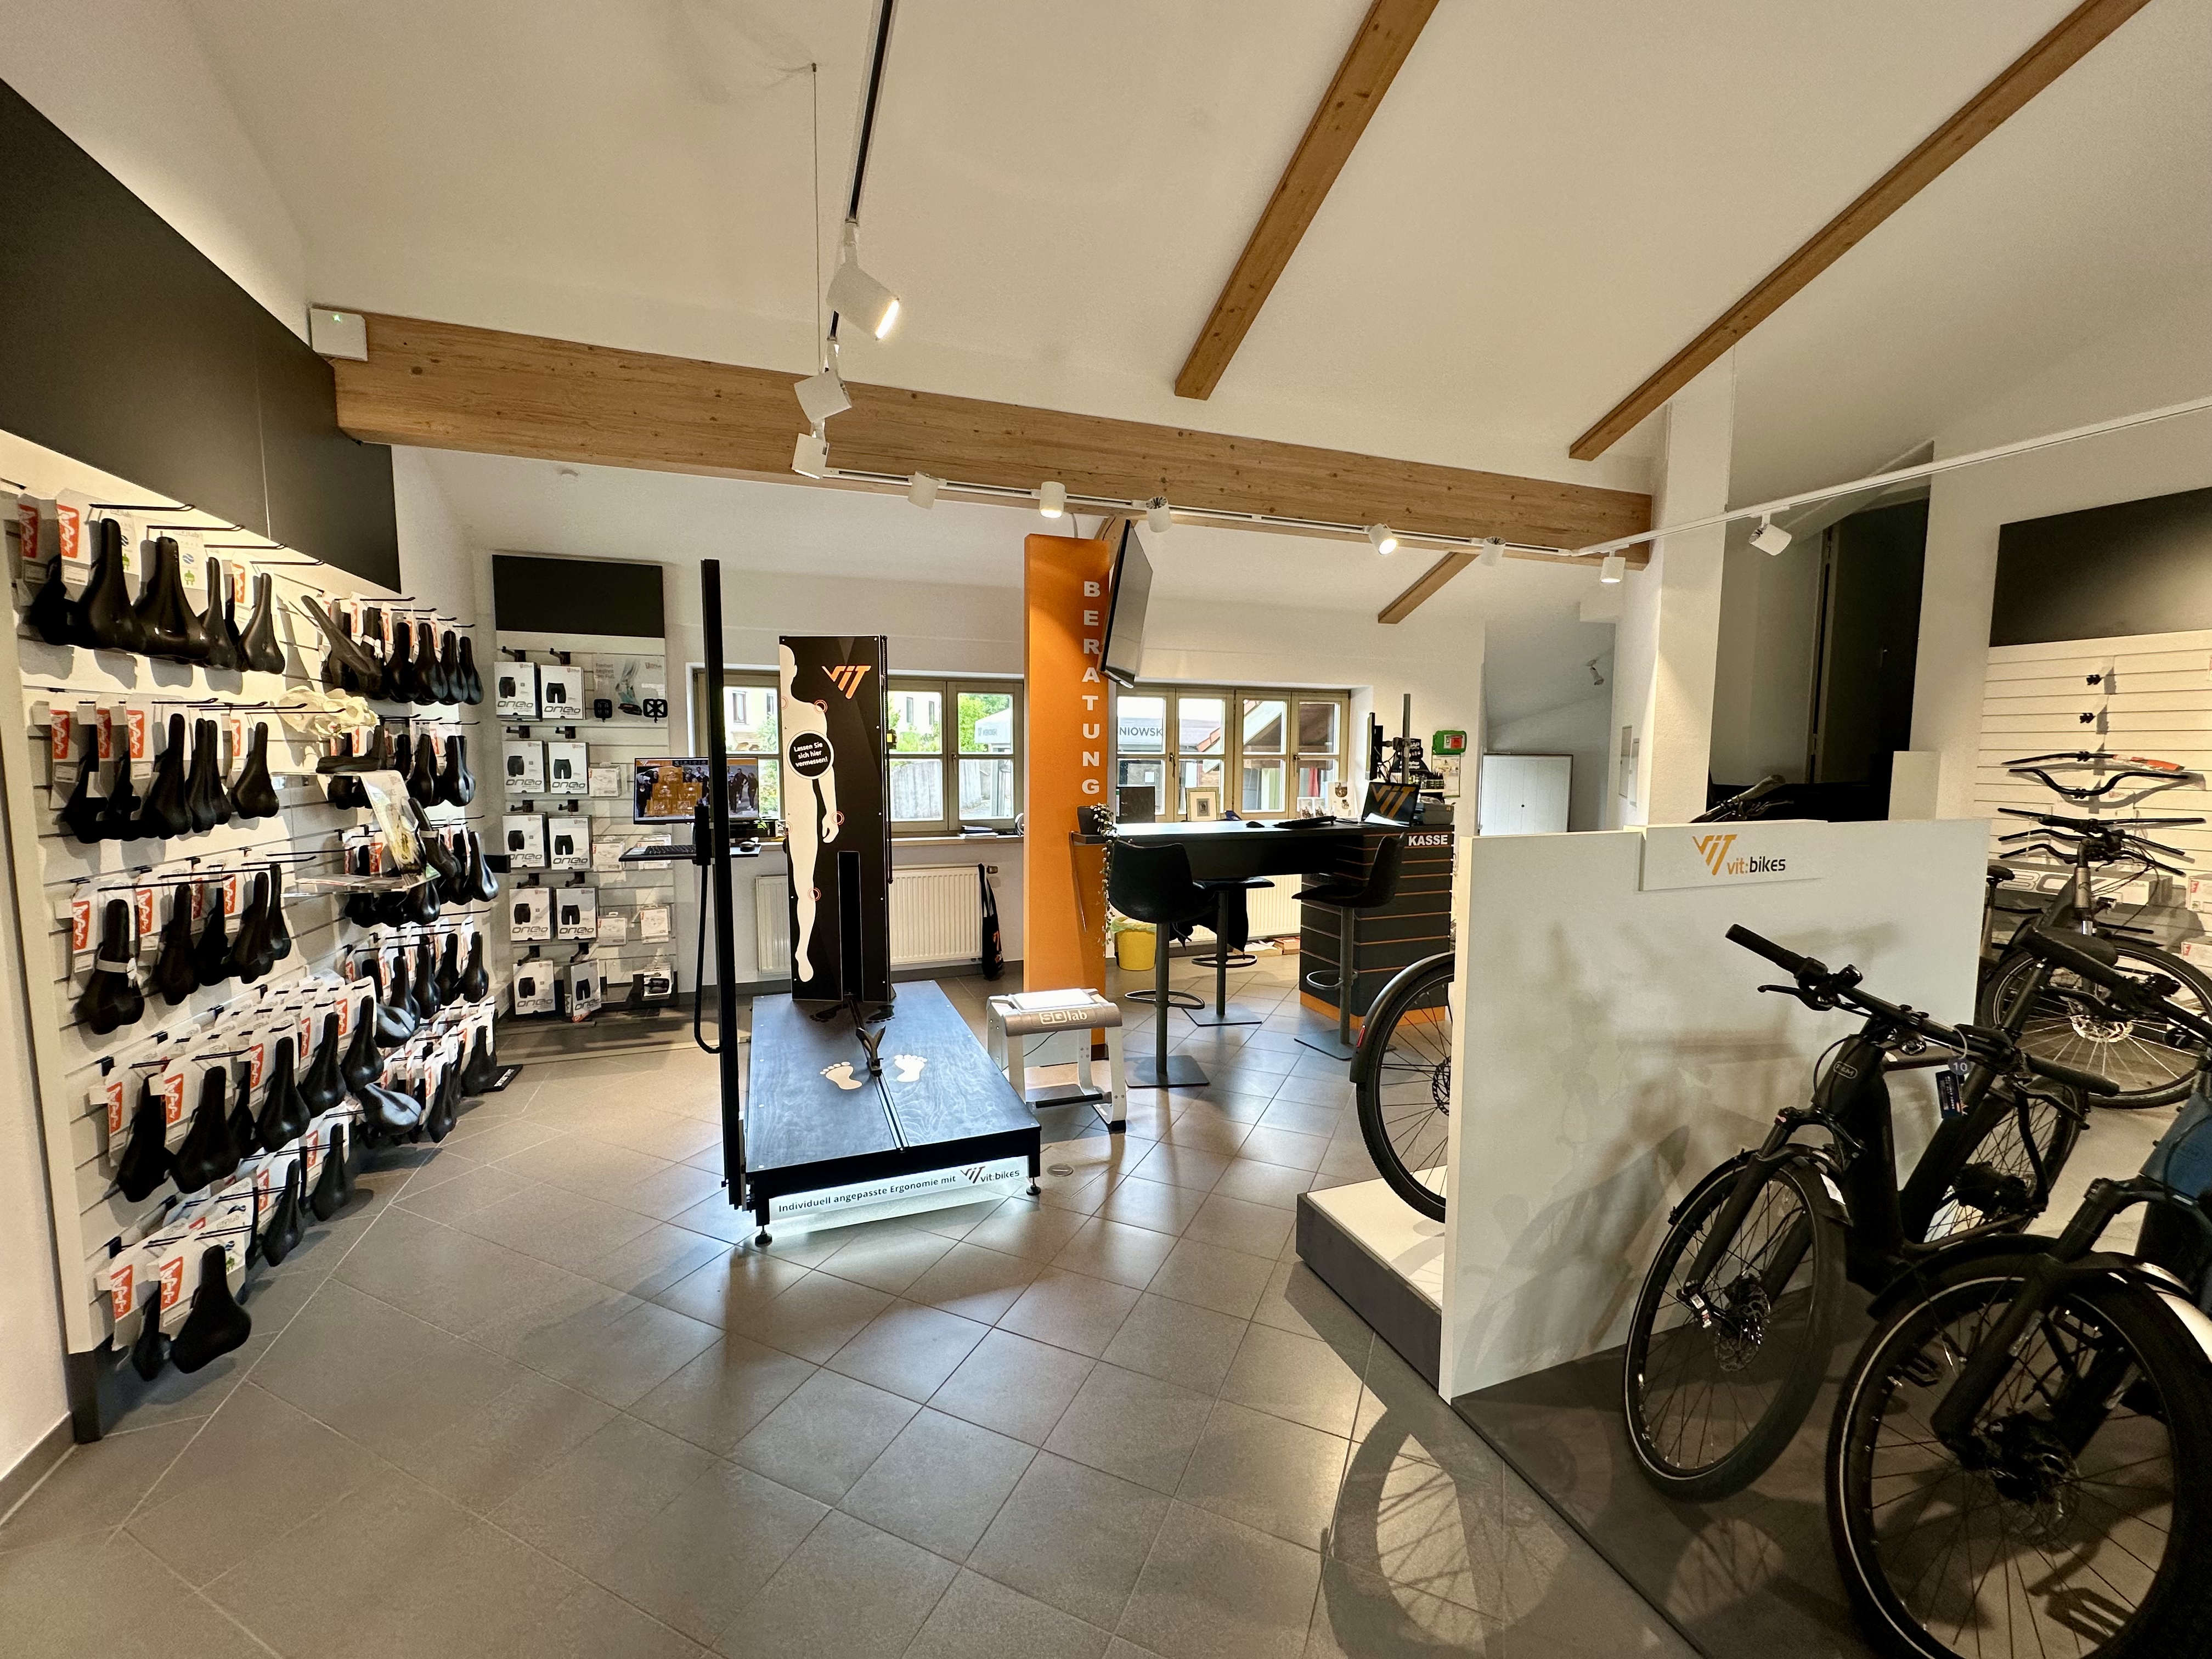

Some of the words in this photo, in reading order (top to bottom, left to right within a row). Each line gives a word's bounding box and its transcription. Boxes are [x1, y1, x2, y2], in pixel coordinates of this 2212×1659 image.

[1081, 581, 1101, 794] BERATUNG
[795, 756, 828, 767] vermessen!
[1408, 834, 1448, 846] KASSE
[1727, 856, 1786, 874] vit:bikes
[1039, 1010, 1087, 1024] SQlab
[2174, 1034, 2186, 1046] 7
[1953, 1062, 1968, 1072] 10
[779, 1197, 831, 1212] Individuell
[833, 1187, 887, 1202] angepasste
[890, 1178, 938, 1193] Ergonomie
[941, 1175, 956, 1184] mit
